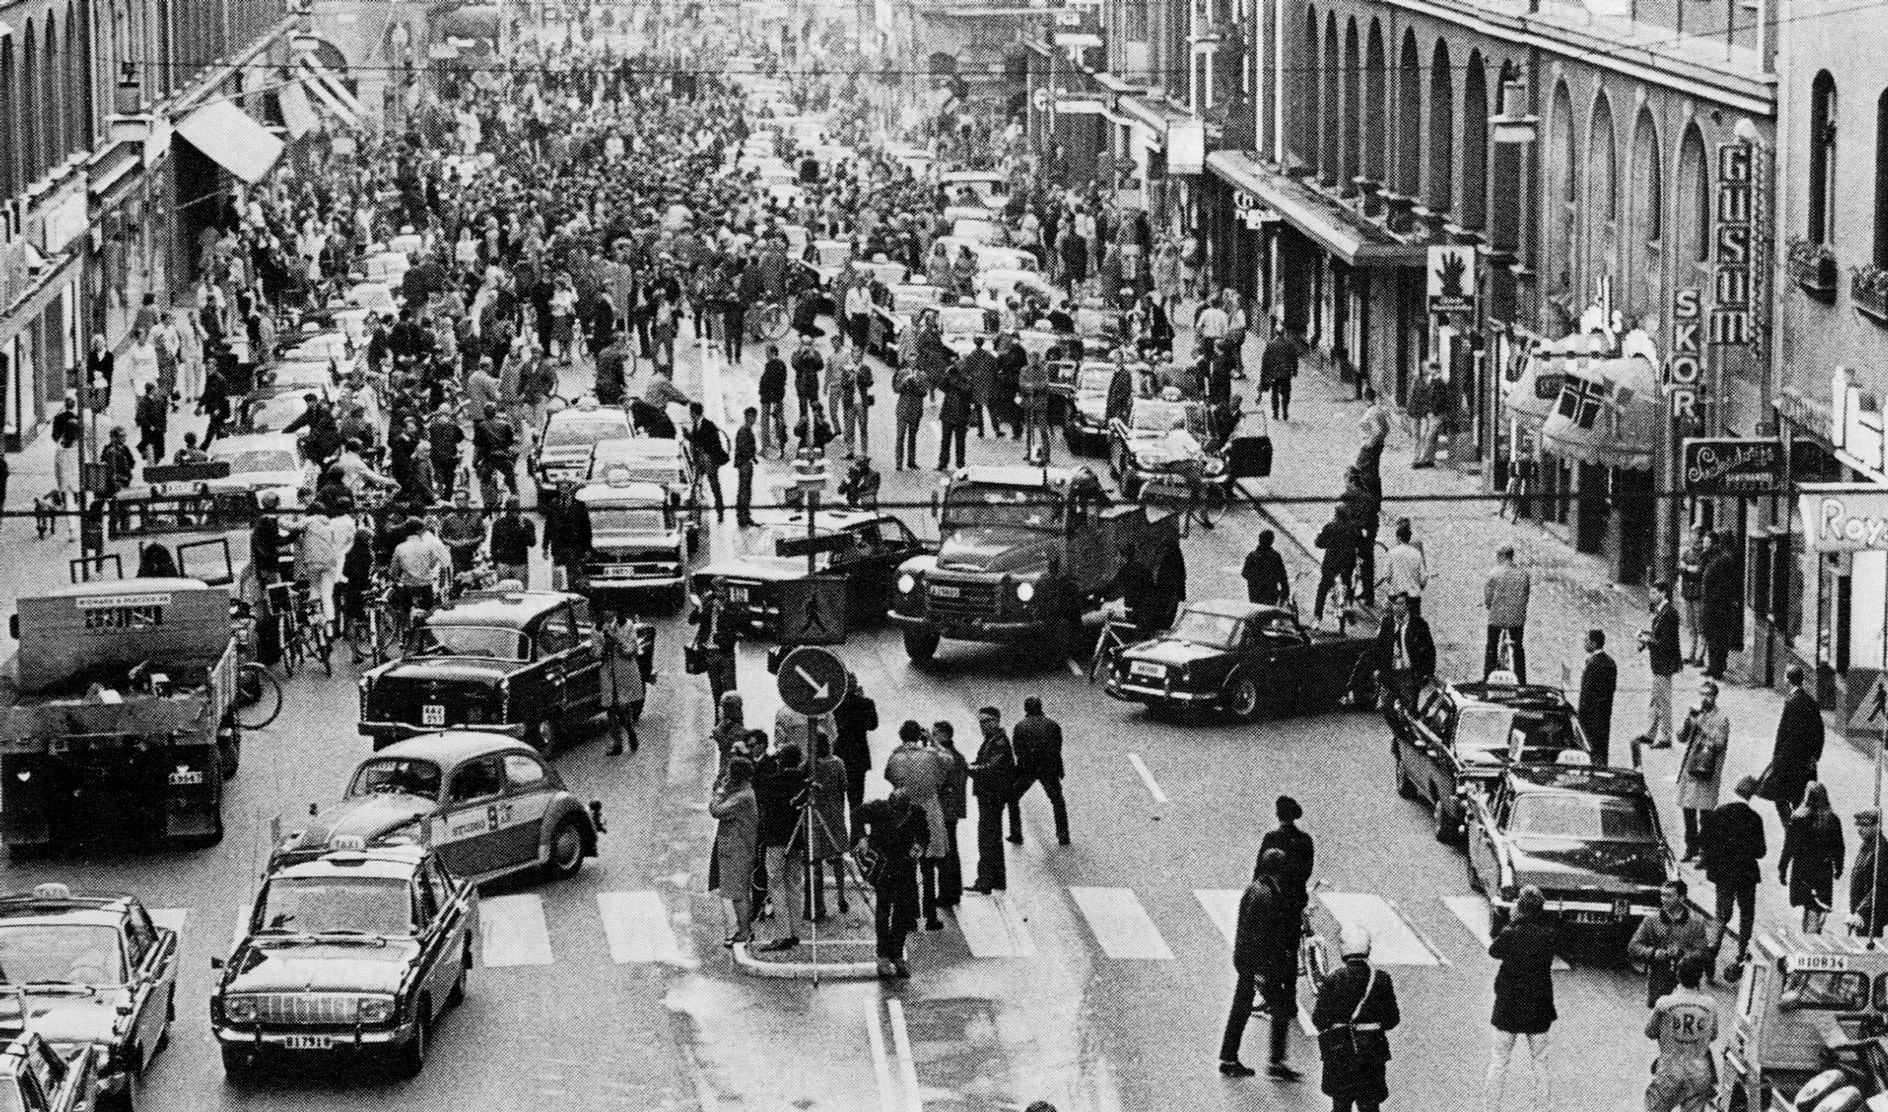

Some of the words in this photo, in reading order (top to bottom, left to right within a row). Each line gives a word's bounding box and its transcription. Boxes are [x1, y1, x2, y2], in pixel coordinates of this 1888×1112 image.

[1673, 290, 1698, 417] SKOR
[1822, 499, 1888, 545] Roy
[335, 839, 360, 849] TAXI
